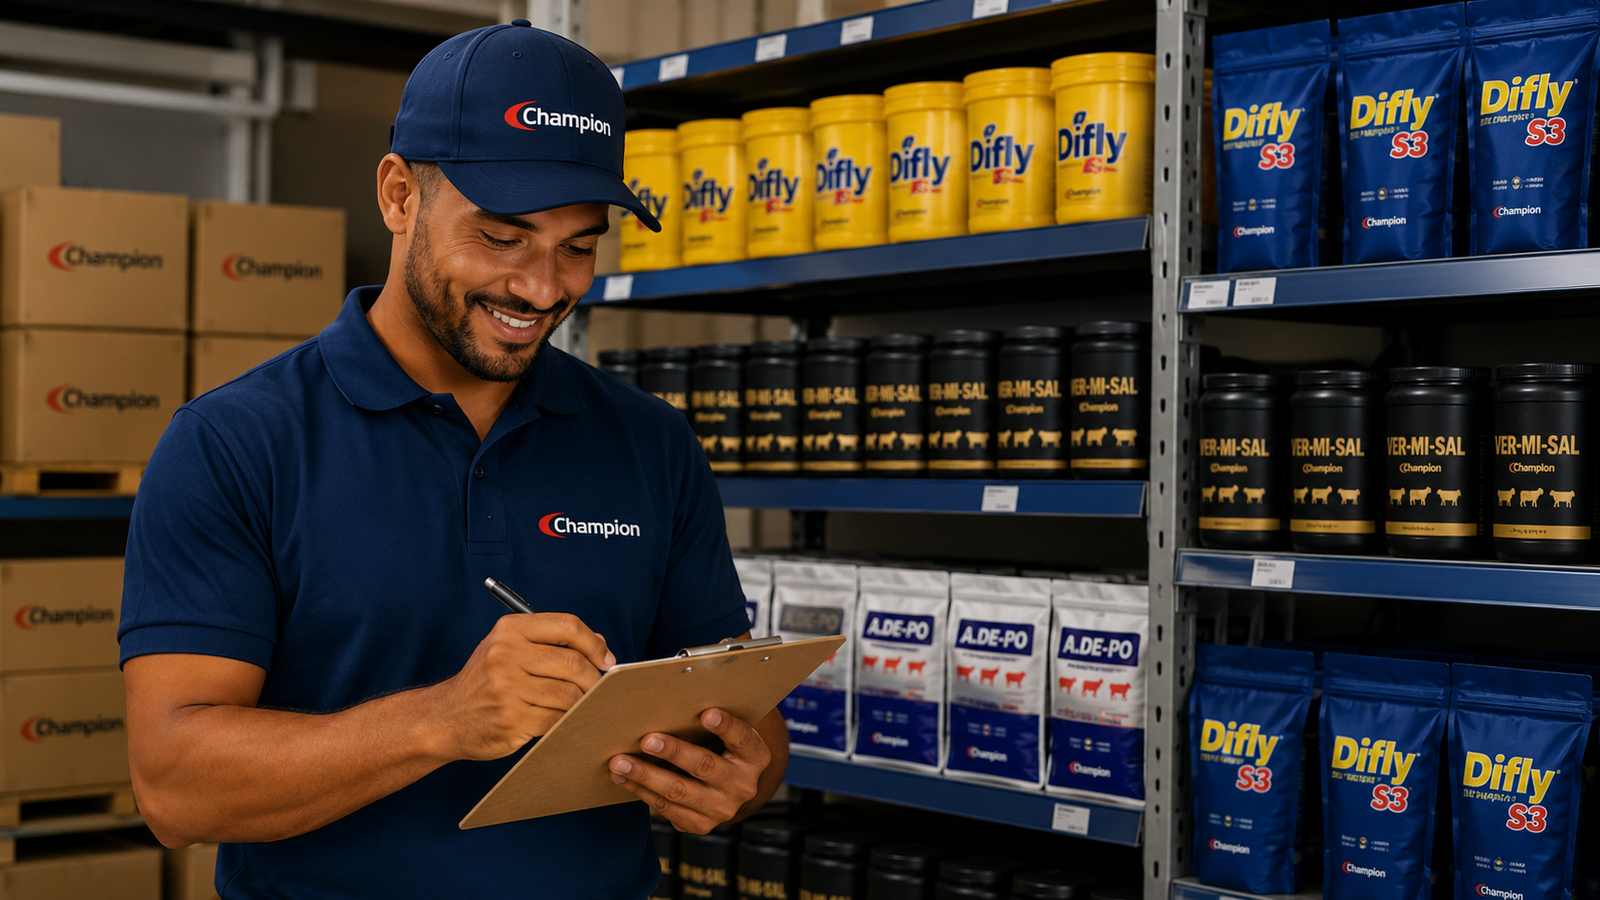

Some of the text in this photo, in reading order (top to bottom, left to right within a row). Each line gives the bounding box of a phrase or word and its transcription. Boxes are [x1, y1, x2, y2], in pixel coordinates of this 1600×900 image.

[1480, 73, 1574, 117] Difly
[523, 107, 611, 136] Champion
[1223, 102, 1301, 143] Difly
[1350, 89, 1435, 130] Difly
[1058, 122, 1128, 164] Difly
[1525, 117, 1566, 146] S3
[970, 135, 1035, 175] Difly
[1258, 143, 1295, 170] S3
[1390, 131, 1428, 159] S3
[890, 147, 951, 186] Difly
[1367, 216, 1407, 227] Champion
[1498, 205, 1541, 216] Champion
[1237, 225, 1275, 236] Champion
[65, 245, 163, 271] Champion
[236, 257, 323, 281] Champion
[62, 388, 160, 412] Champion
[1291, 438, 1365, 457] VER-MI-SAL
[1387, 436, 1466, 456] VER-MI-SAL
[1495, 435, 1580, 455] VER-MI-SAL
[1513, 462, 1556, 474] Champion
[554, 517, 640, 539] Champion
[28, 606, 115, 627] Champion
[867, 616, 931, 641] A.DE-PO
[959, 625, 1029, 650] A.DE-PO
[1062, 634, 1134, 660] A.DE-PO
[35, 715, 125, 739] Champion
[1200, 719, 1279, 766] Difly
[1331, 736, 1416, 785] Difly
[1235, 764, 1272, 793] S3
[1463, 751, 1556, 804] Difly
[1370, 784, 1409, 813] S3
[1506, 802, 1547, 833] S3
[1346, 863, 1386, 878] Champion
[1480, 885, 1524, 900] Champion
